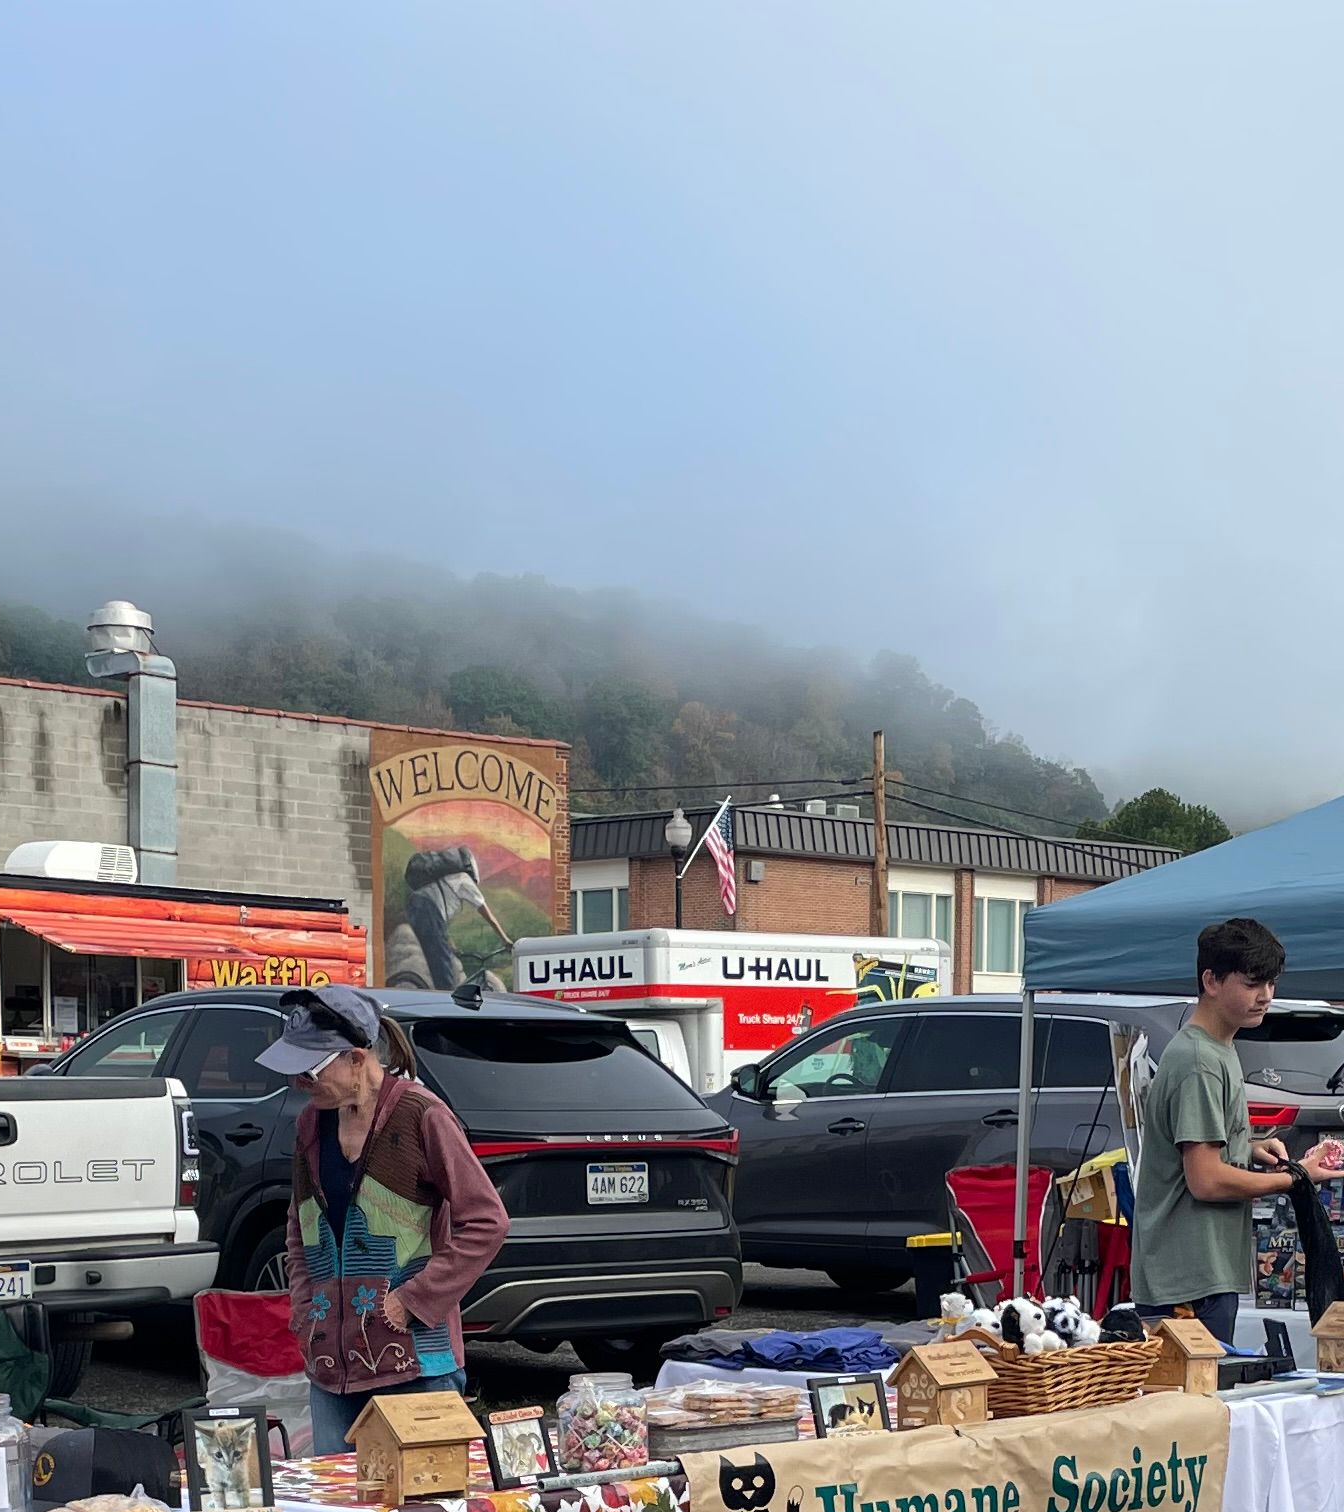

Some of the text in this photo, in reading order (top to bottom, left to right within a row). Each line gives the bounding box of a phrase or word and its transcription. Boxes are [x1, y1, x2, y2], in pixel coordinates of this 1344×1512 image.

[376, 750, 556, 825] WELCOME
[211, 957, 332, 988] Waffle
[529, 955, 633, 985] U-HAUL
[722, 956, 829, 982] U-HAUL
[738, 1013, 806, 1026] Truck Share 24/7
[592, 1175, 645, 1195] 4AM 622
